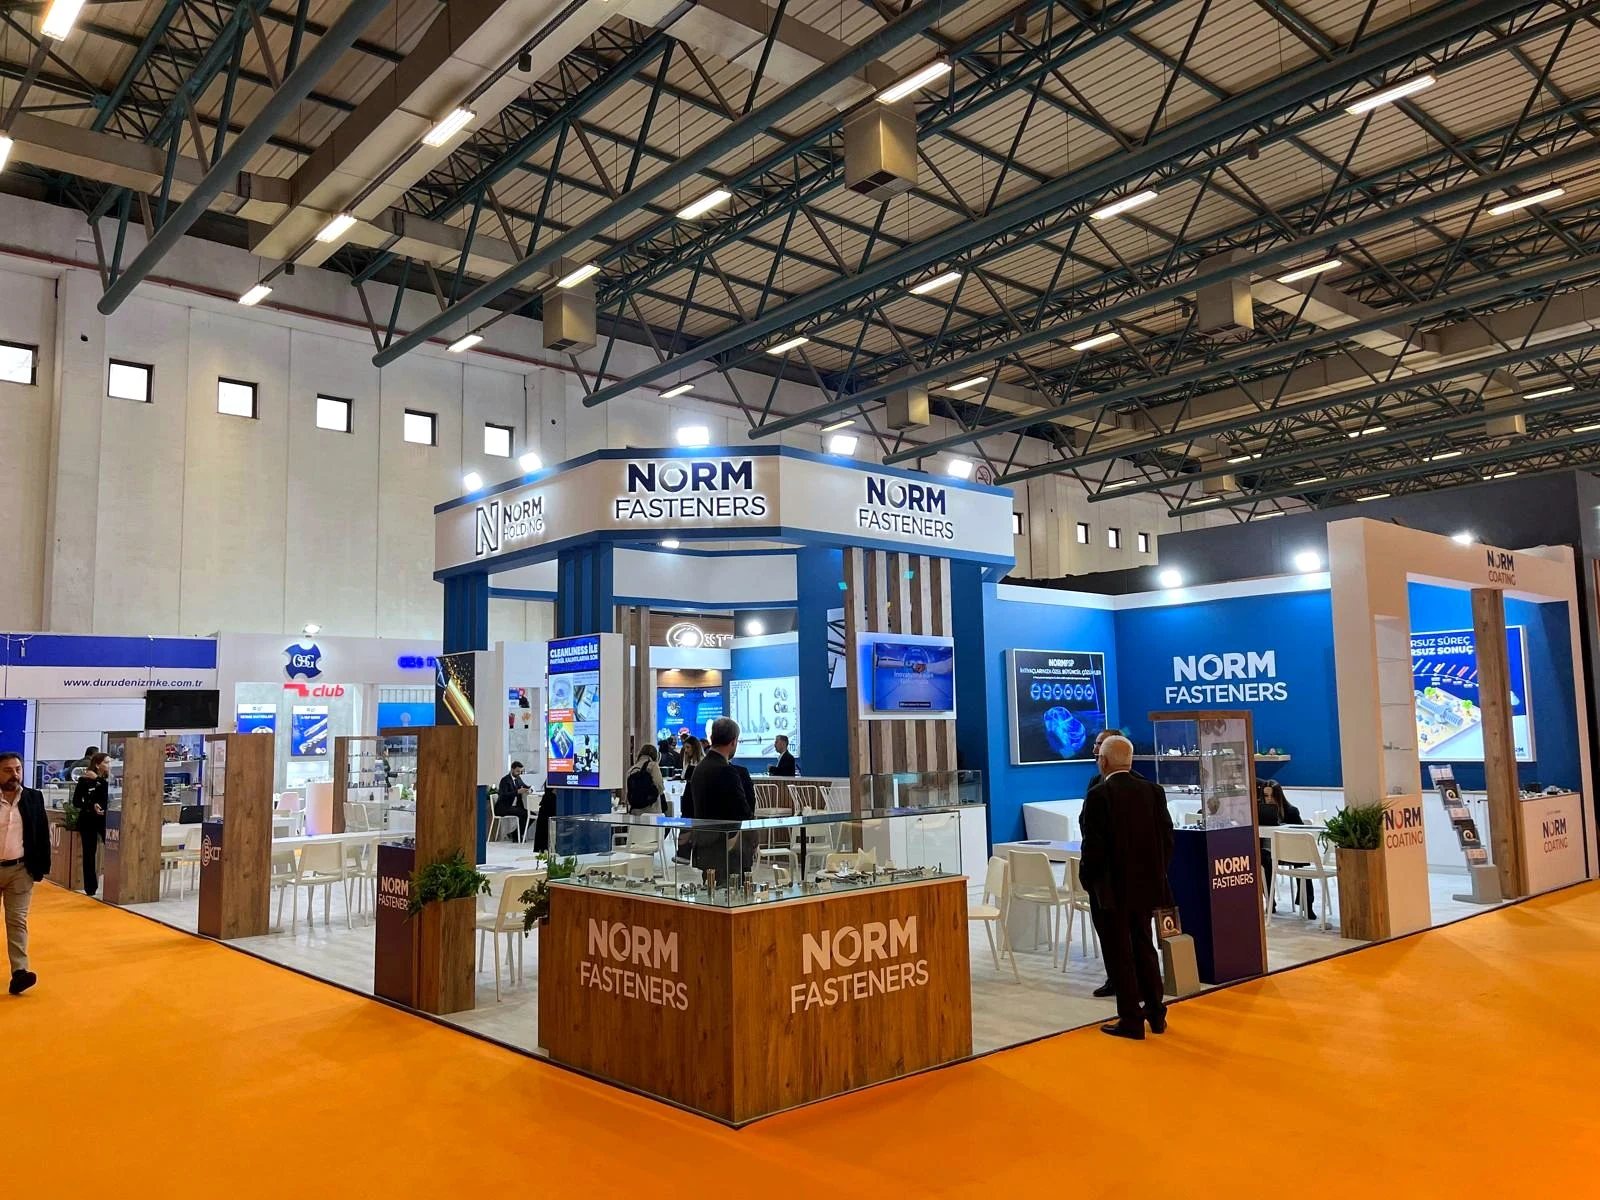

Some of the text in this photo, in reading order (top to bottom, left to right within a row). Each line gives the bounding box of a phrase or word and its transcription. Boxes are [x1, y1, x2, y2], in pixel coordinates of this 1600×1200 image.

[628, 461, 753, 493] NORM
[866, 477, 946, 515] NORM
[503, 496, 542, 524] NORM
[615, 496, 766, 519] FASTENERS
[503, 519, 543, 539] HOLDING
[859, 509, 954, 539] FASTENERS
[1487, 549, 1515, 571] NORM
[1488, 570, 1516, 585] COATING
[550, 645, 588, 658] CLEANLINESS
[1437, 636, 1471, 646] SÜREÇ
[1437, 645, 1474, 655] SONUÇ
[1173, 650, 1276, 682] NORM
[63, 678, 203, 687] www.durudenizmke.com.tr
[312, 685, 345, 697] club
[1165, 682, 1288, 704] FASTENERS
[1384, 807, 1422, 831] NORM
[1542, 818, 1567, 839] NORM
[1386, 831, 1424, 849] COATING
[1543, 837, 1568, 853] COATING
[1214, 856, 1250, 875] NORM
[381, 876, 409, 896] NORM
[1212, 873, 1254, 889] FASTENERS
[378, 893, 409, 911] FASTENER
[588, 918, 678, 973] NORM
[802, 915, 917, 974] NORM
[580, 961, 689, 1011] FASTENERS
[791, 960, 929, 1014] FASTENERS
